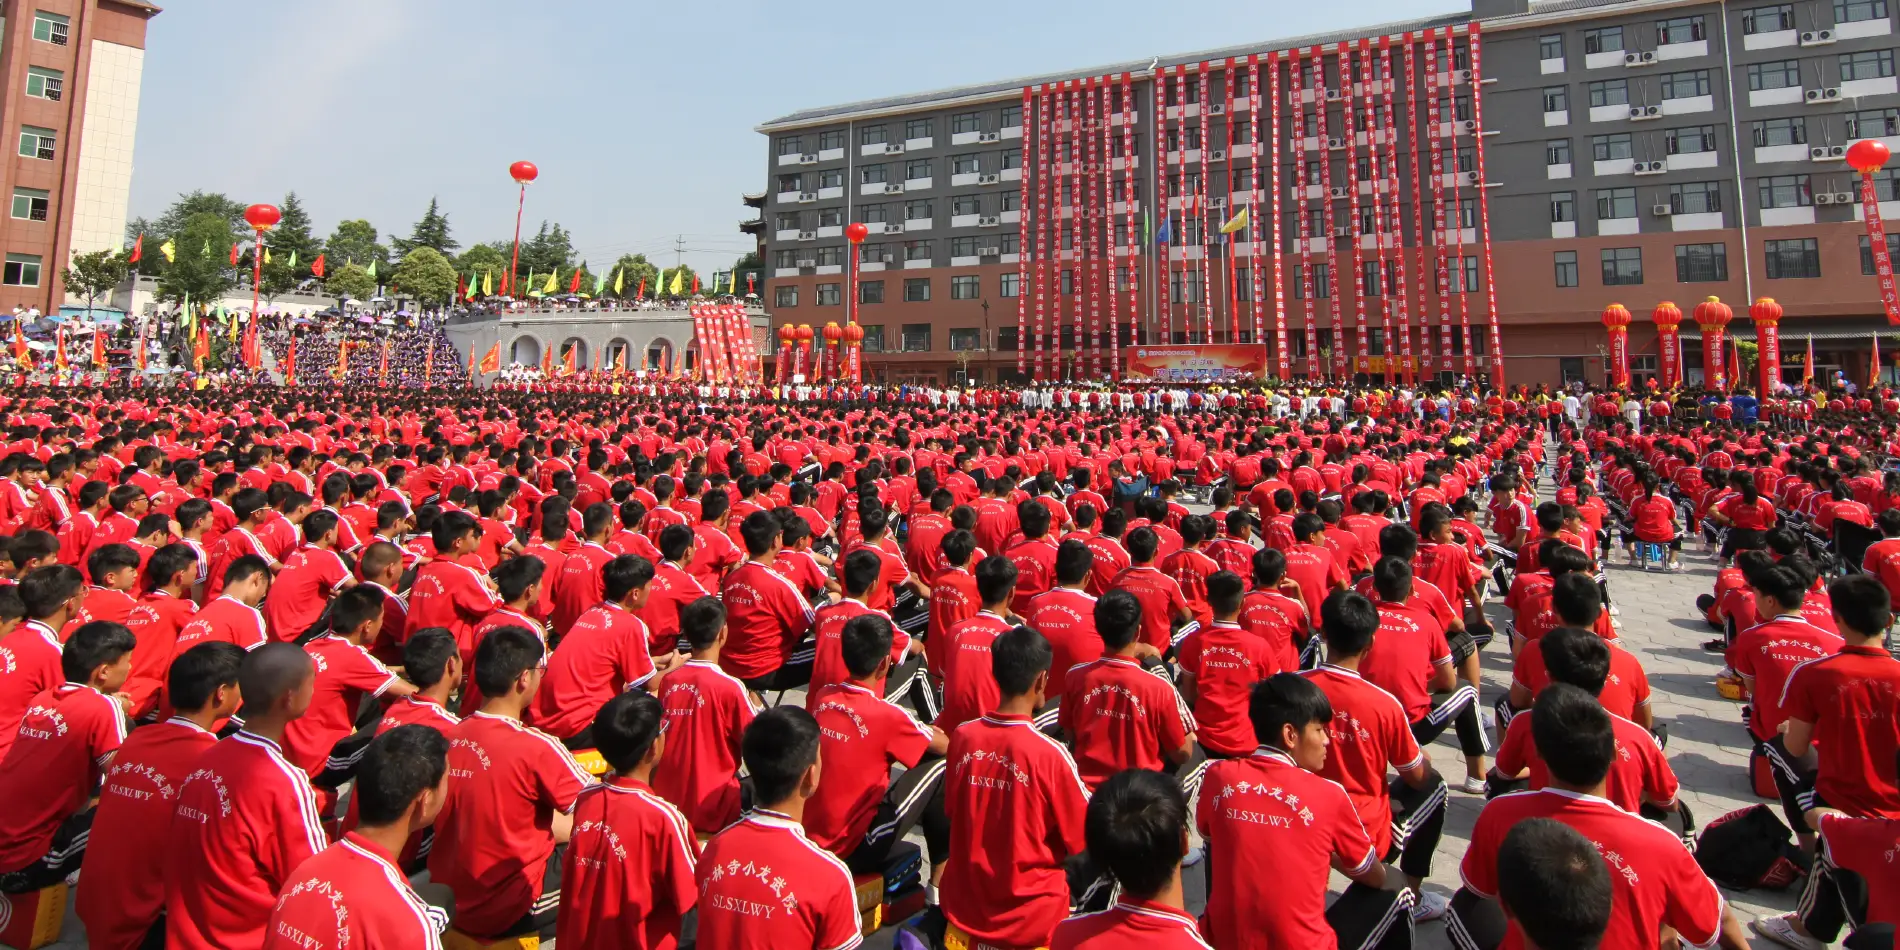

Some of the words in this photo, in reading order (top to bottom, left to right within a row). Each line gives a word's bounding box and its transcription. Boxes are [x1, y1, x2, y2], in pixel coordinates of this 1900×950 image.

[1205, 661, 1241, 669] SLSXLWY
[109, 783, 153, 801] SLSXLWY
[1226, 808, 1293, 828] SLSXLWY
[712, 894, 776, 919] SLSXLWY
